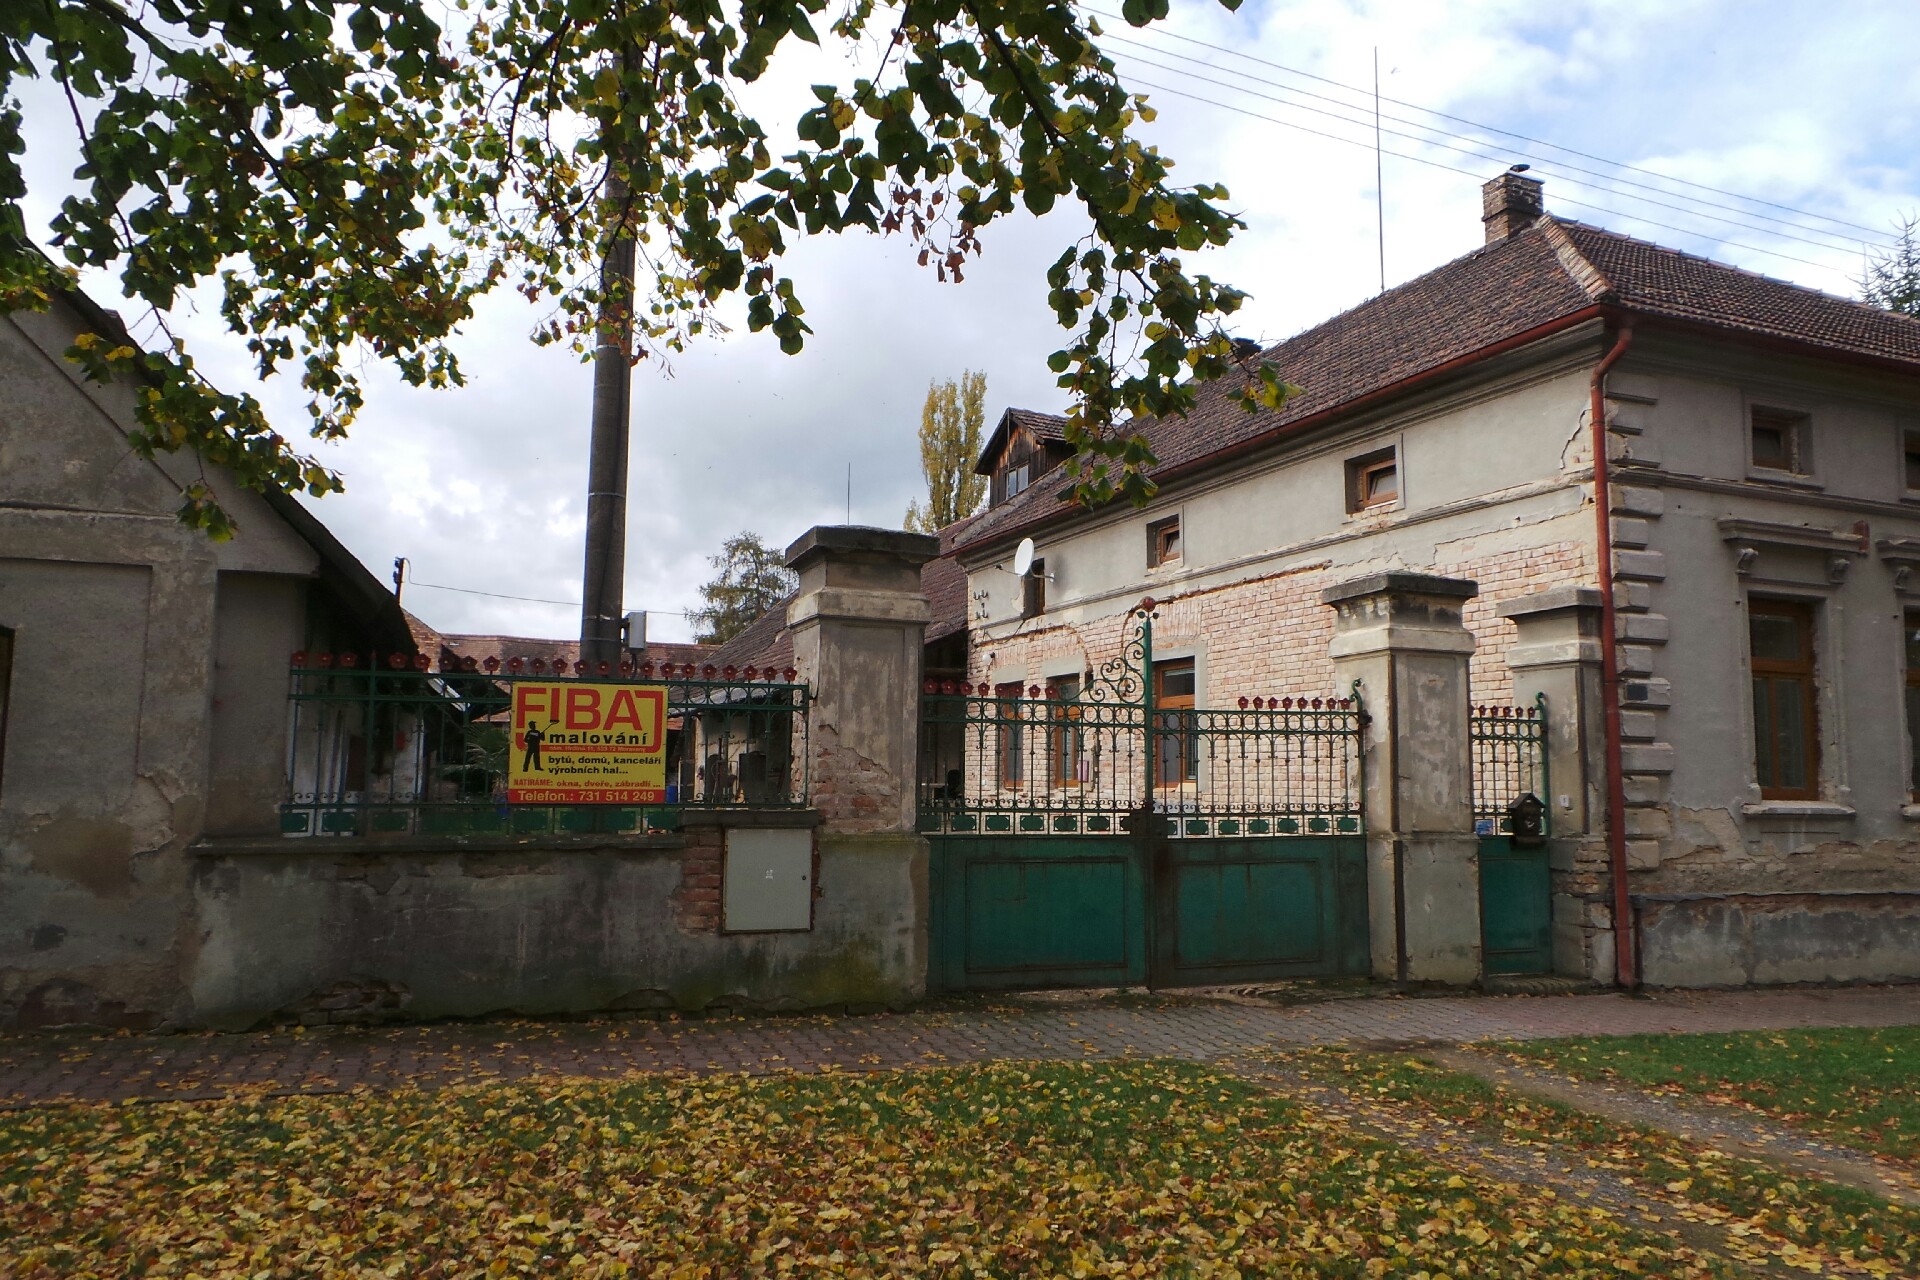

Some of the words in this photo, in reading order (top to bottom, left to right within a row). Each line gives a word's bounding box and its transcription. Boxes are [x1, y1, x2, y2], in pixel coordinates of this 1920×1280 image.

[549, 731, 648, 745] malování
[548, 756, 575, 765] bytů,
[578, 756, 610, 765] domů,
[613, 756, 661, 764] kanceláří
[548, 766, 599, 775] výrobních
[579, 791, 600, 801] 731
[605, 791, 628, 801] 514
[632, 791, 655, 801] 249
